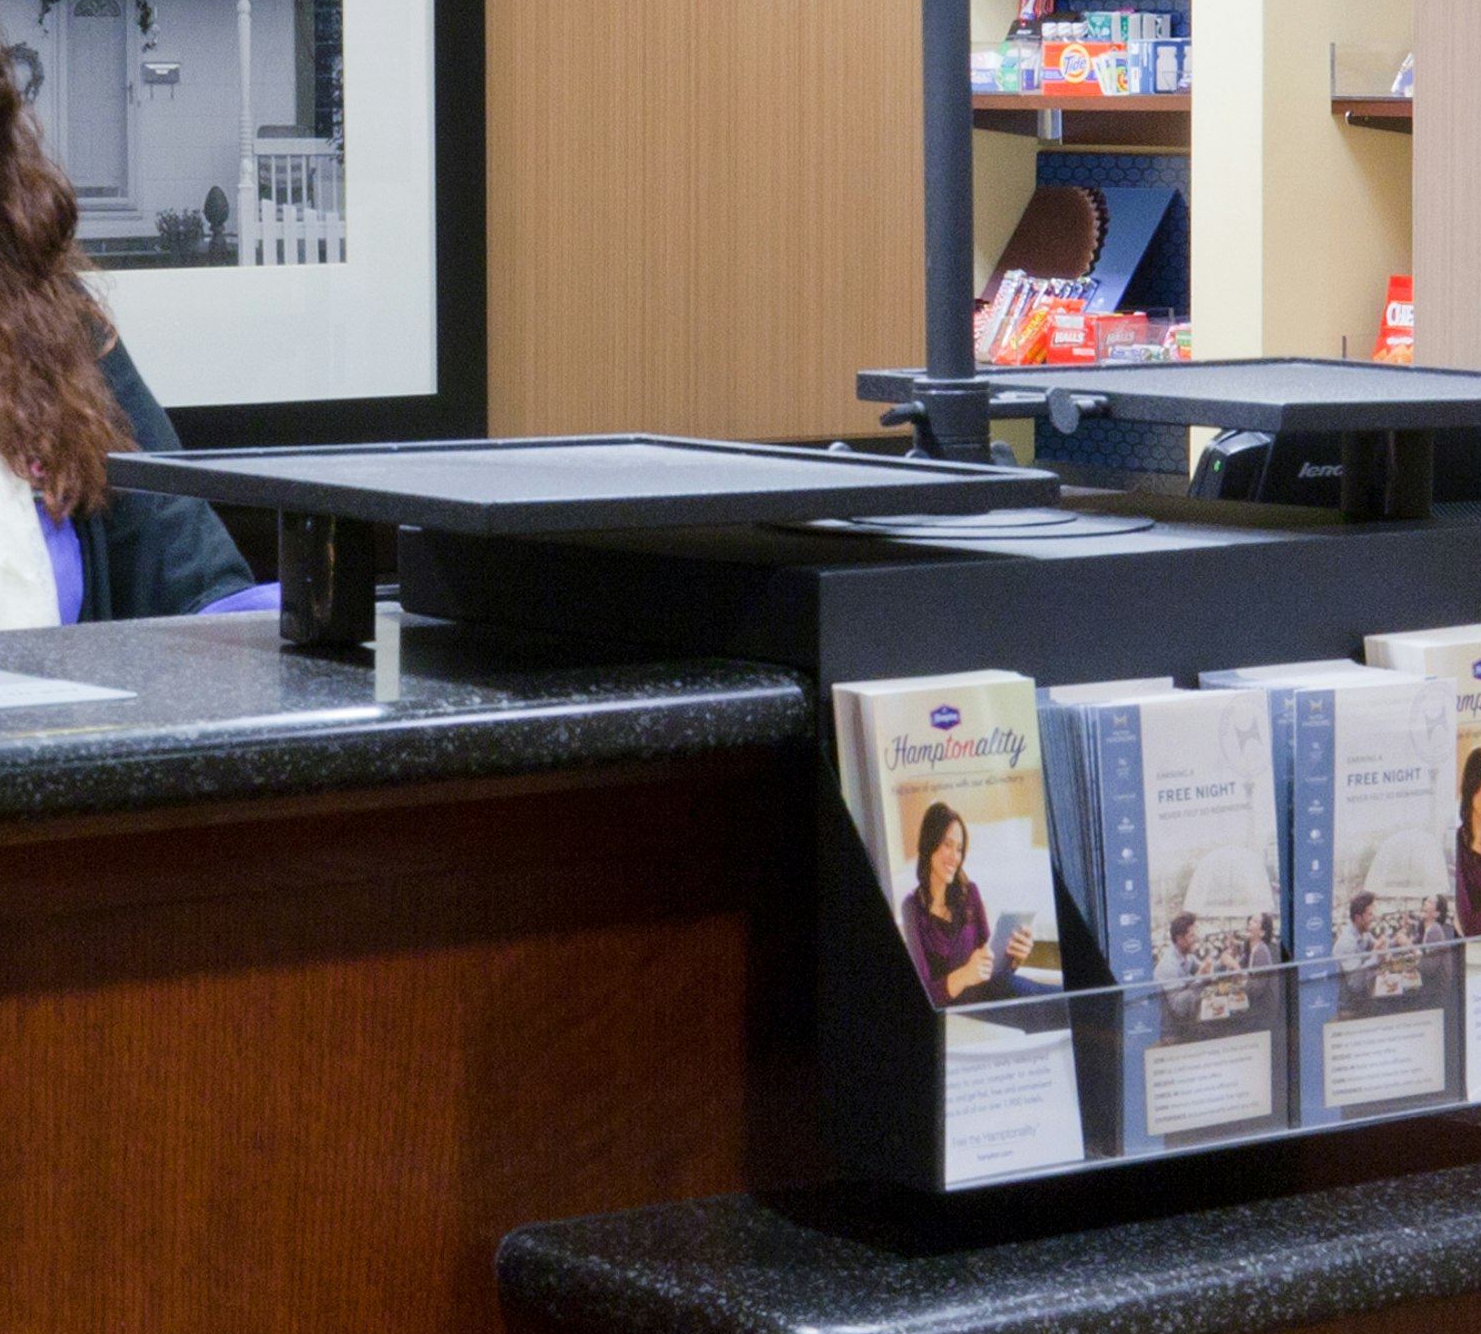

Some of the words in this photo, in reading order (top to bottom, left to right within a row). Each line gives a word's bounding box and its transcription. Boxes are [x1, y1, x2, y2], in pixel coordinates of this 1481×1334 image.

[1063, 55, 1087, 75] Tide
[1054, 330, 1086, 344] HALLS
[1298, 462, 1344, 478] leno
[885, 726, 1027, 771] Hamptonality
[1347, 771, 1379, 787] FREE
[1382, 767, 1422, 784] NIGHT
[1157, 787, 1192, 804] FREE
[1195, 782, 1236, 799] NIGHT
